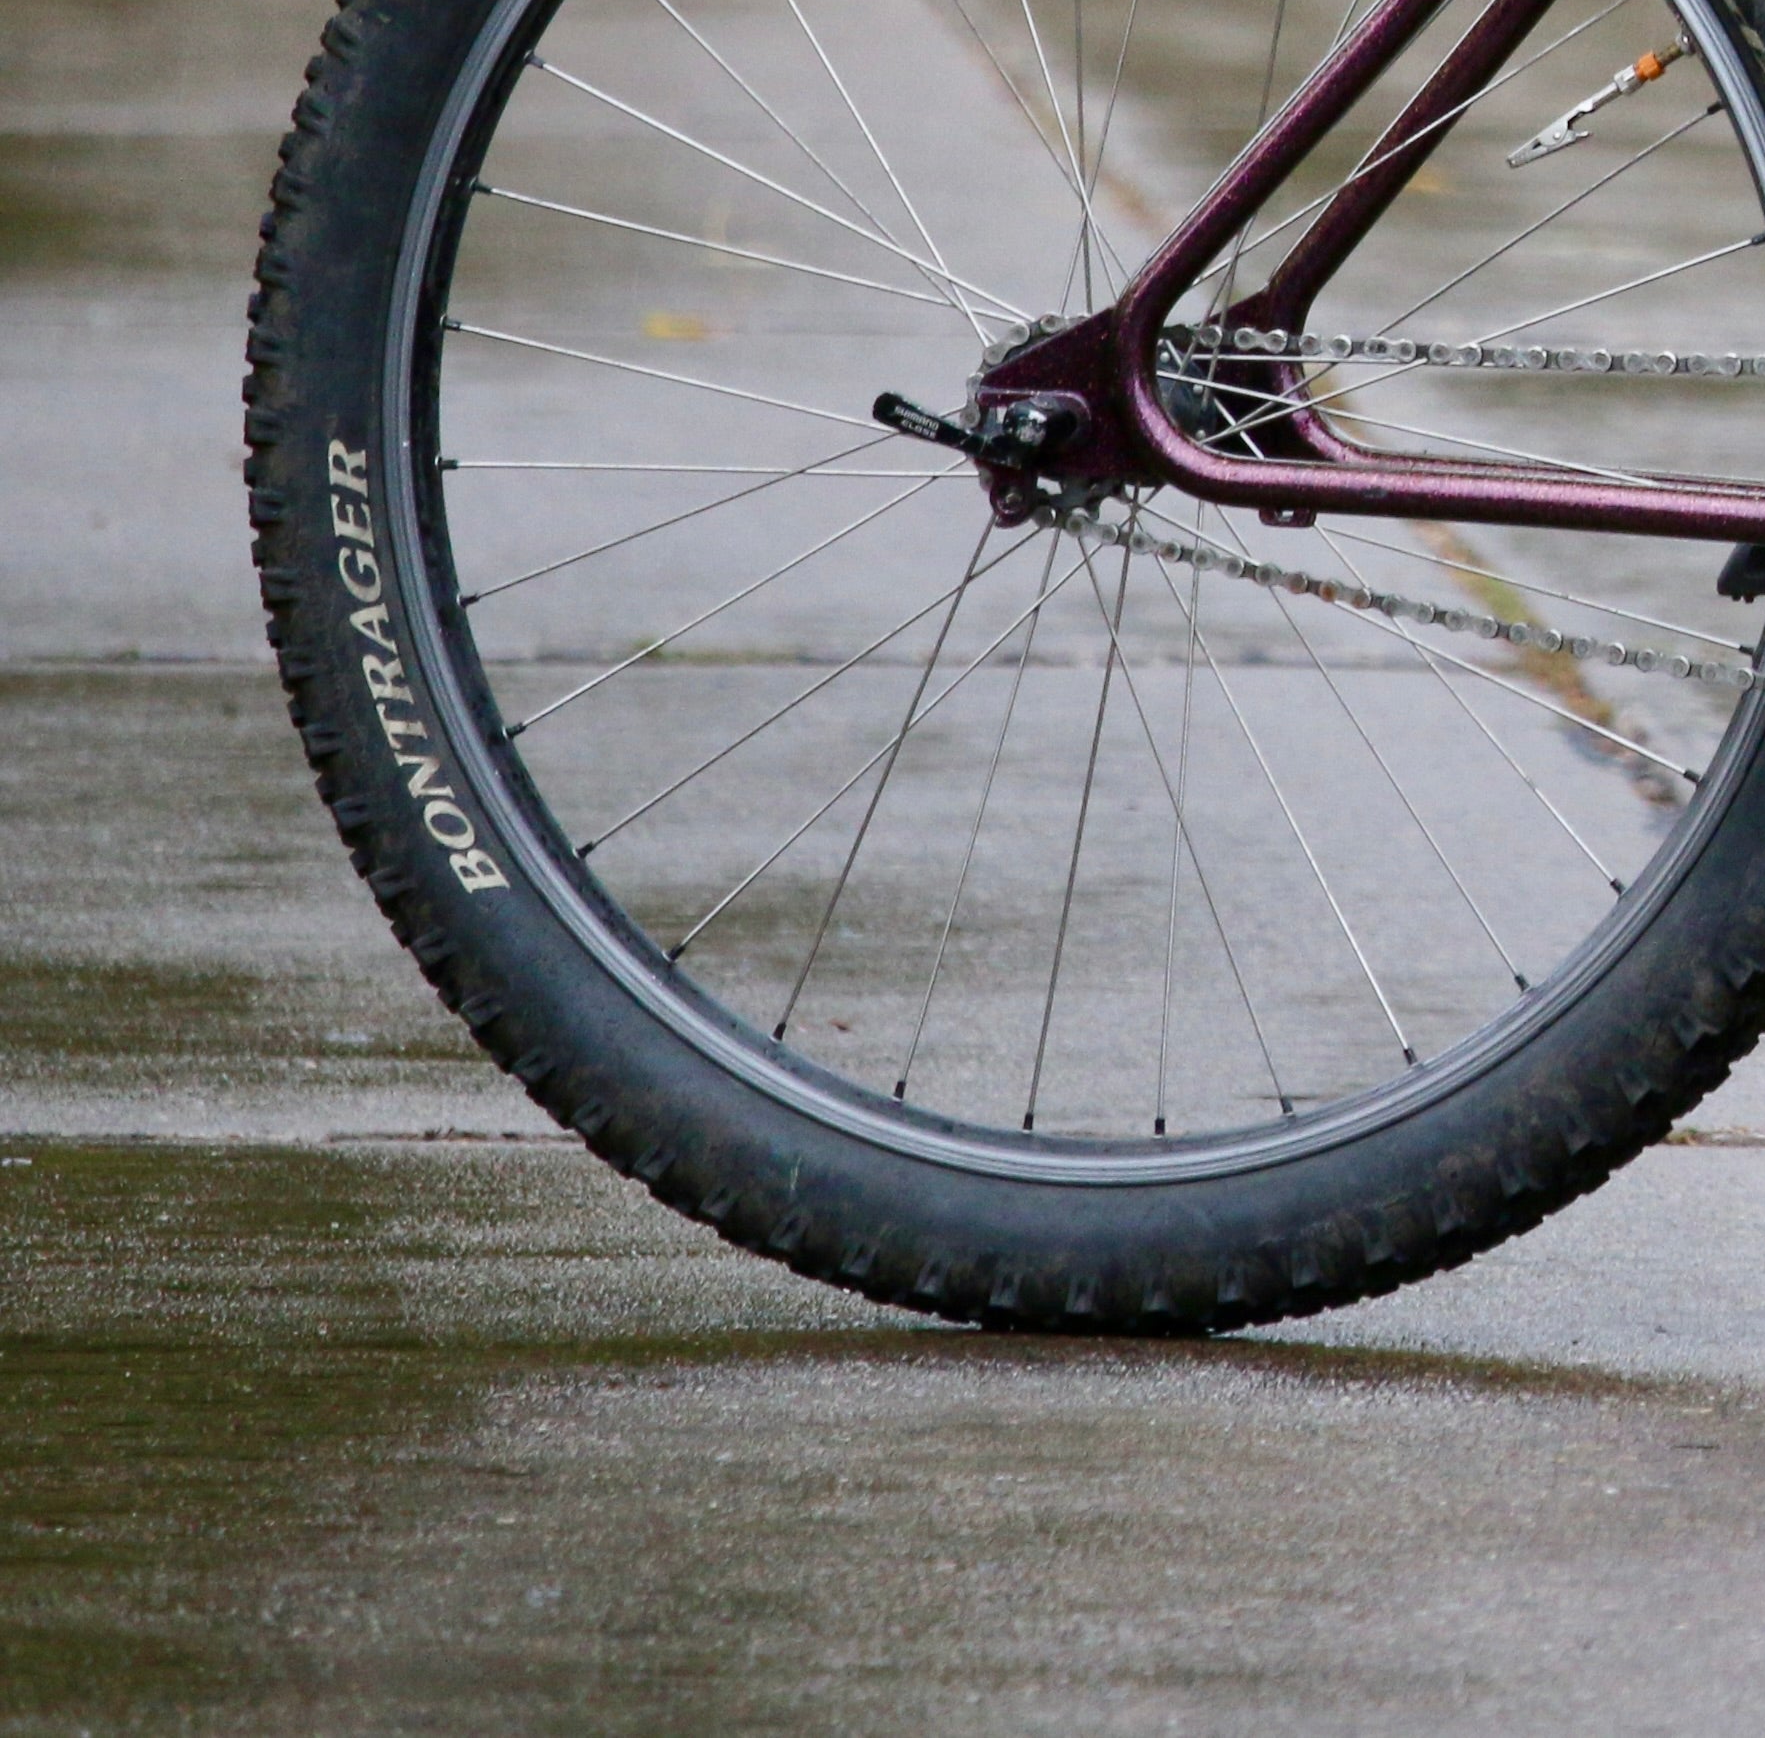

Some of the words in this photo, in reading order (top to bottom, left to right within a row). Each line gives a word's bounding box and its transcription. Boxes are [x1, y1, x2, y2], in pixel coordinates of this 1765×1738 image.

[894, 405, 940, 431] SHIMANO
[901, 418, 936, 439] CLOSE
[327, 437, 511, 896] BONTRAGER
